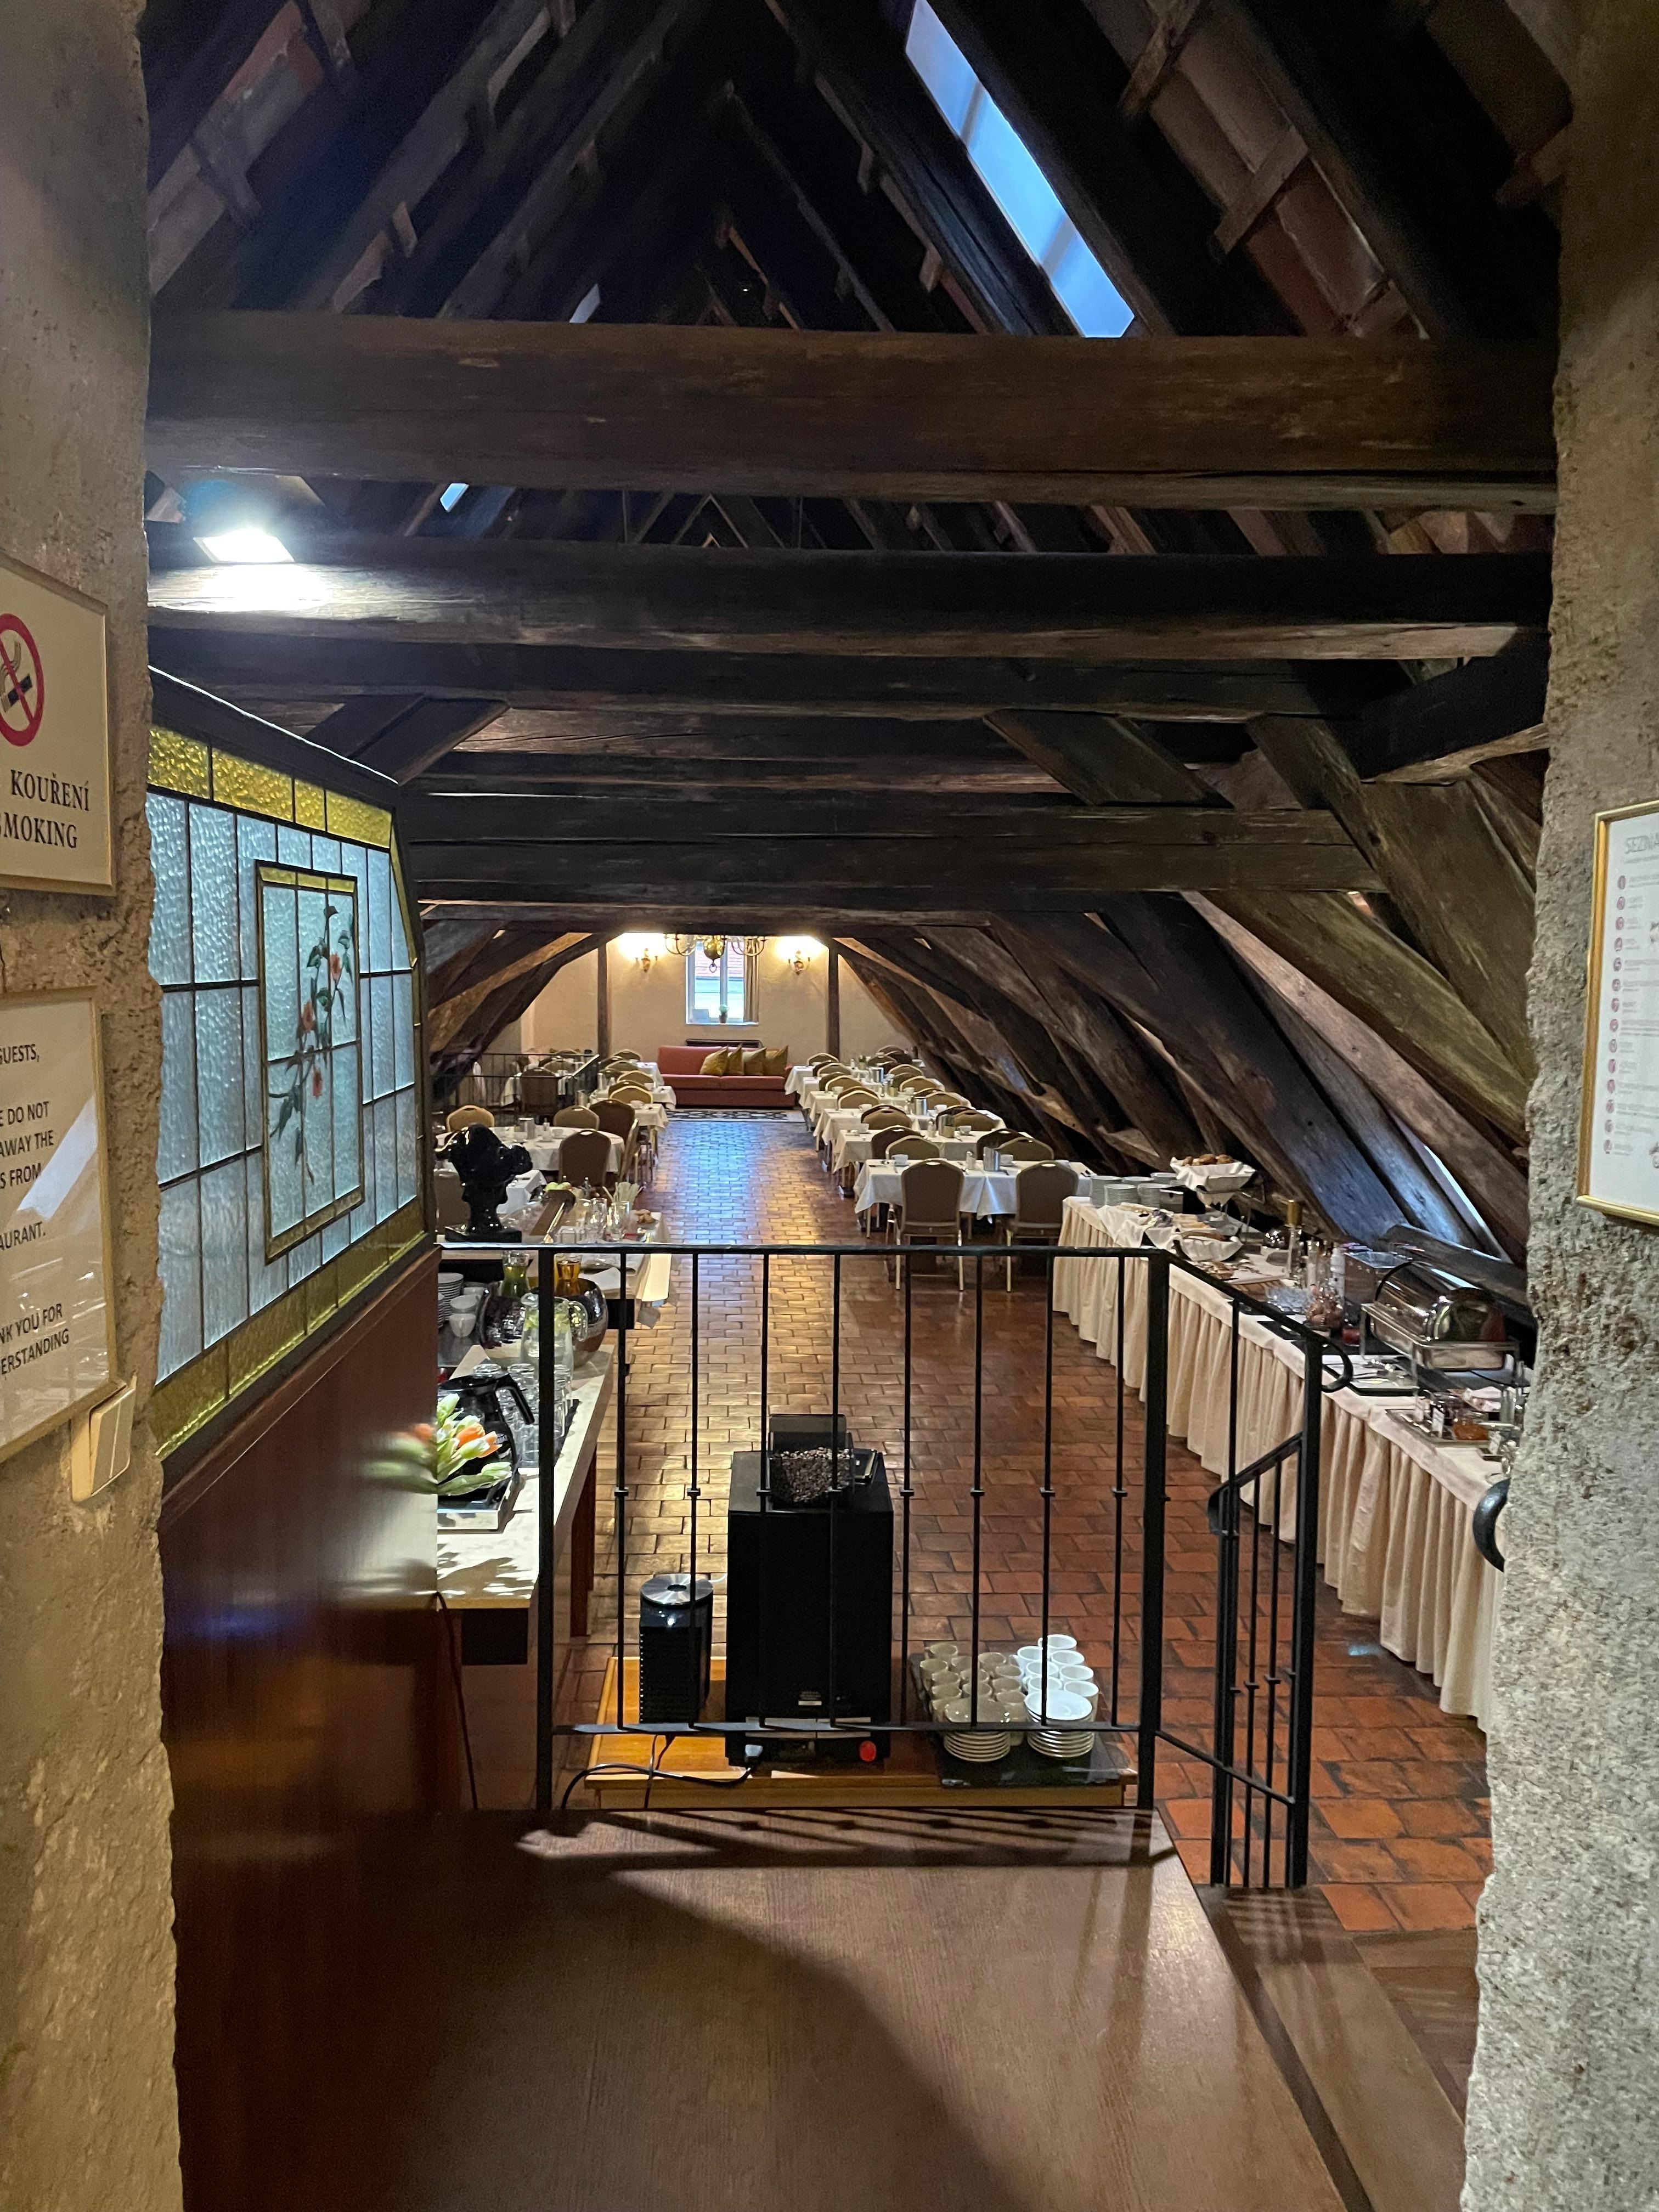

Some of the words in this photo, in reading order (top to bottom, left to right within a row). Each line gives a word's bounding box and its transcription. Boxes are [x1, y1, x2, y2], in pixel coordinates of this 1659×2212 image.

[10, 769, 90, 811] KOUŘENÍ
[0, 812, 77, 849] MOKING
[8, 1107, 24, 1125] DO
[27, 1101, 49, 1121] NOT
[34, 1130, 54, 1149] THE
[9, 1163, 42, 1187] FROM
[15, 1312, 40, 1336] YOU
[43, 1304, 62, 1326] FOR
